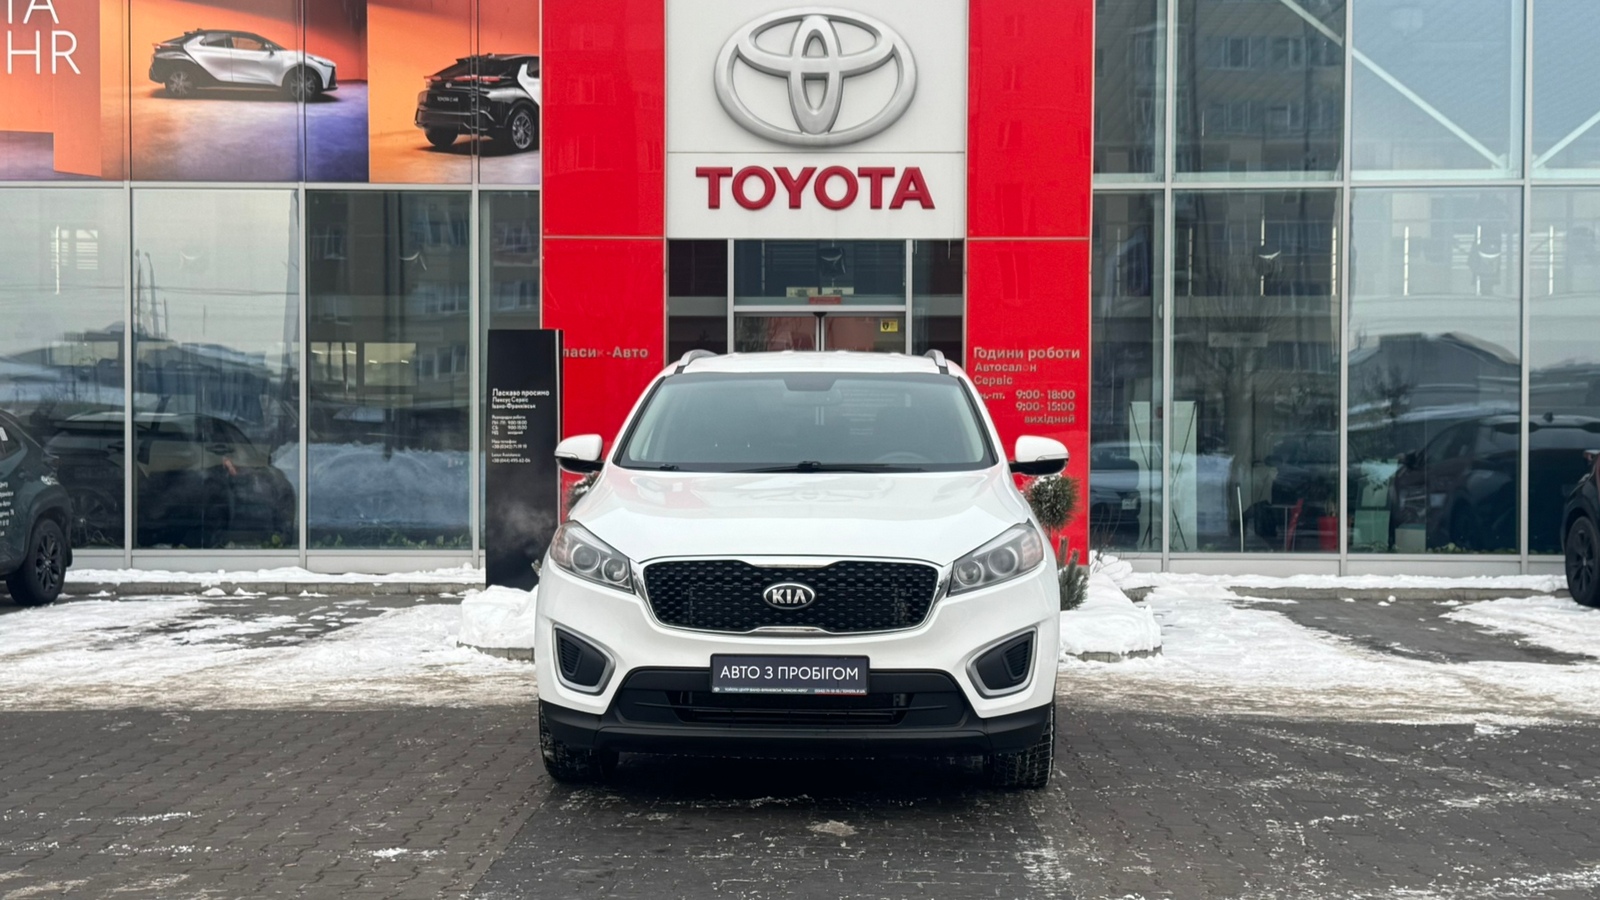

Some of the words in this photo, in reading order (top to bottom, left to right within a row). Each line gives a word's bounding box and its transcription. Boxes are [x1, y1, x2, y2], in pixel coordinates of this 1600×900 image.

[696, 165, 936, 211] TOYOTA
[973, 346, 1024, 360] Години
[1028, 346, 1080, 362] роботи
[973, 375, 1013, 387] Сервіс
[521, 390, 550, 398] просимо
[1024, 414, 1075, 425] вихідний
[772, 589, 807, 604] KIA
[720, 665, 760, 679] АВТО
[778, 666, 859, 680] ПРОБІГОМ
